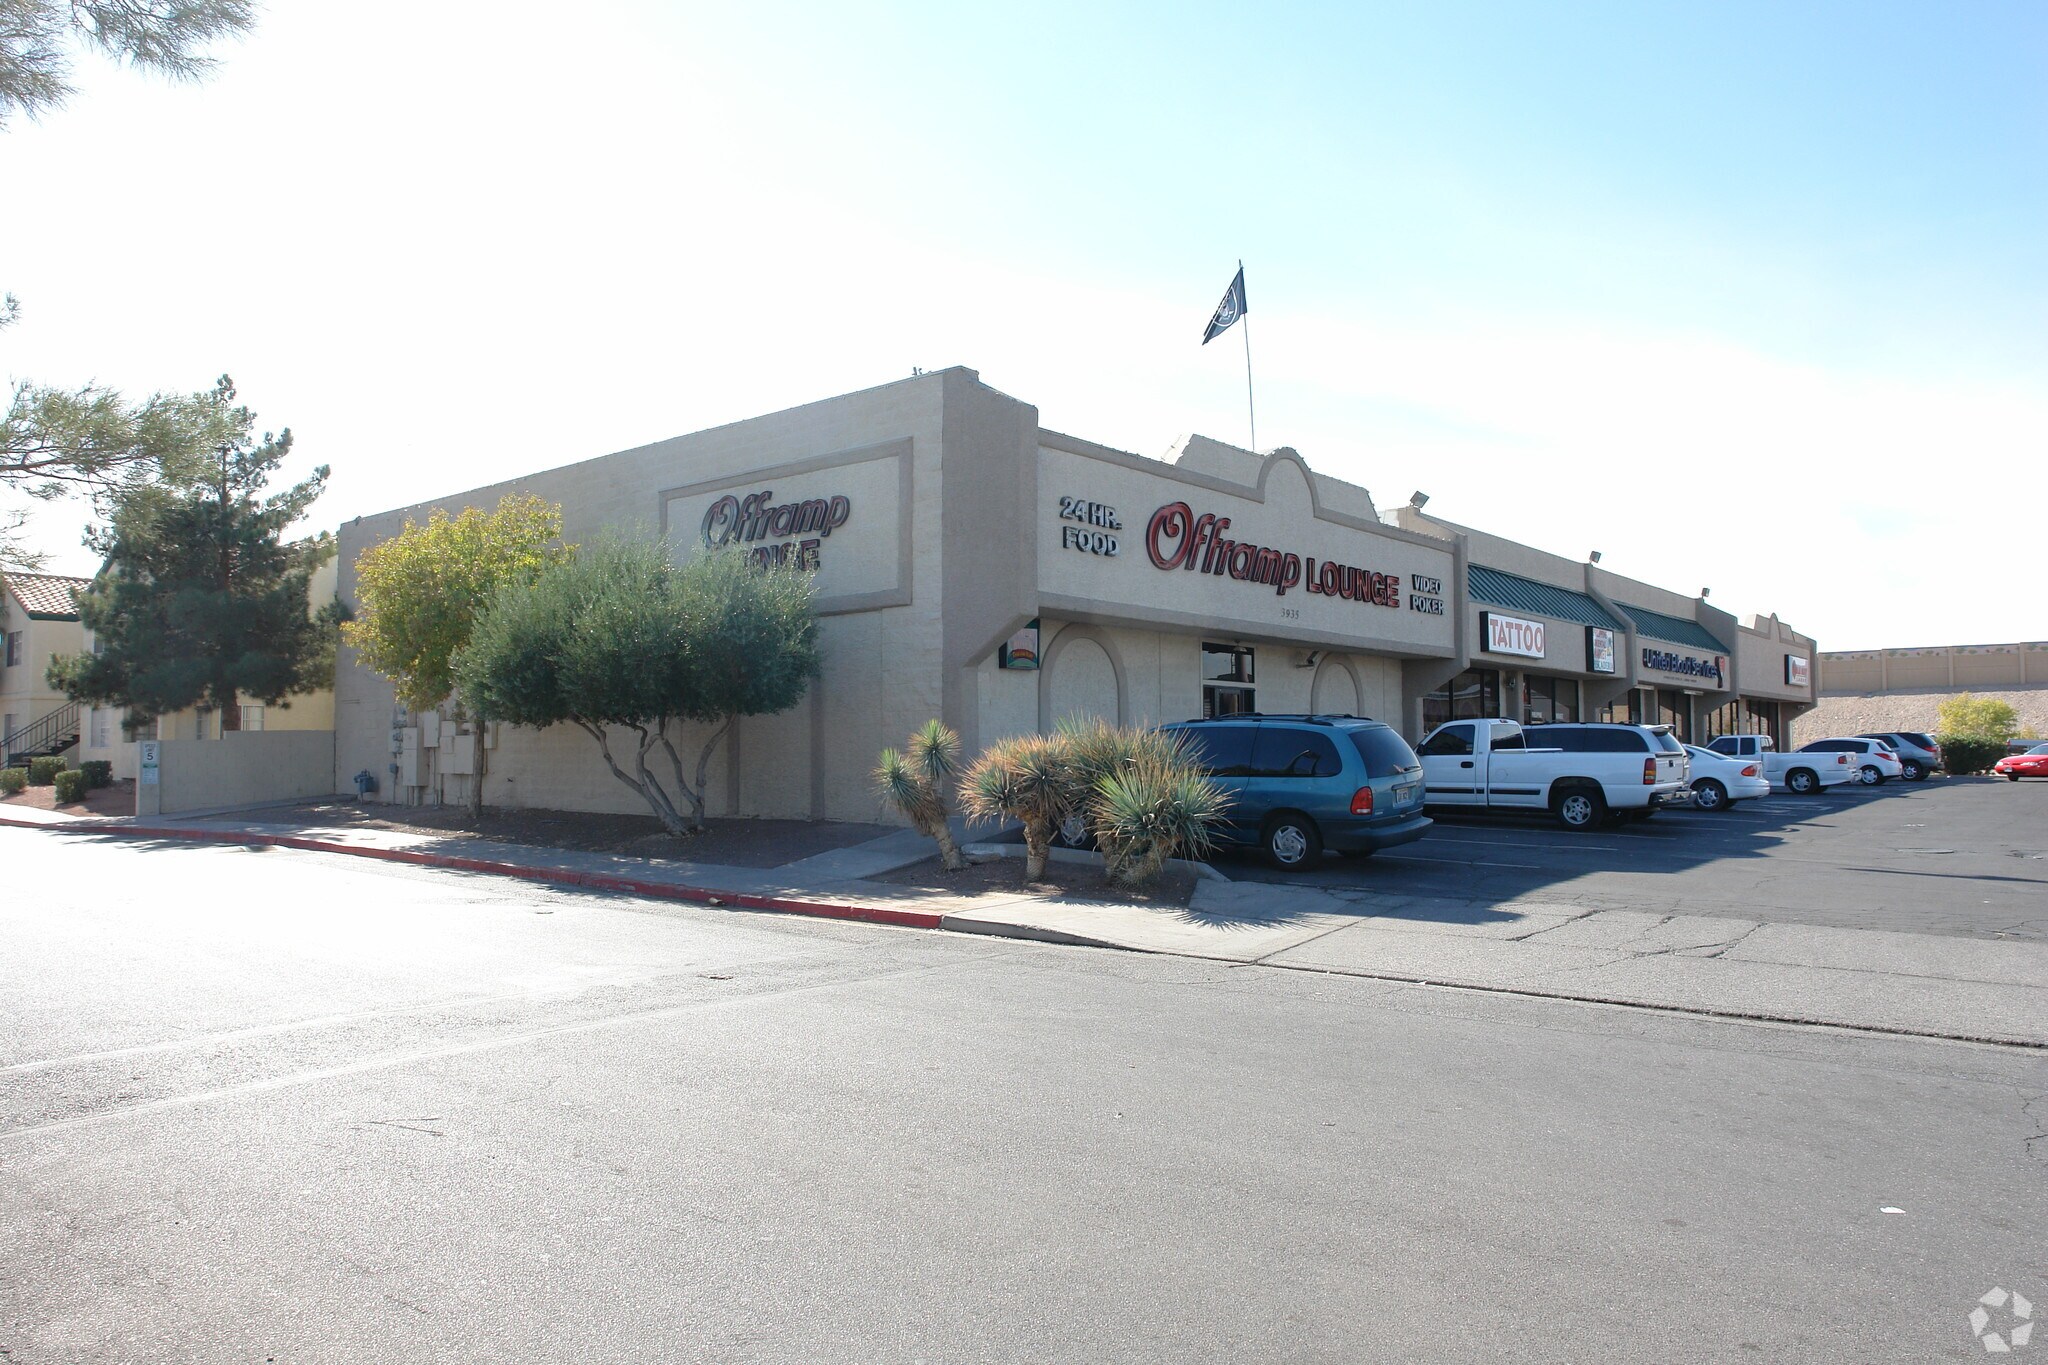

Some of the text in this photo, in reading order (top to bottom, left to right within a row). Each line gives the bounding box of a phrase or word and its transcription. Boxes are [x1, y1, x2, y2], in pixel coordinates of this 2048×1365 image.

[701, 490, 850, 549] Offramp
[1059, 496, 1087, 522] 24
[1062, 526, 1120, 557] FOOD
[1145, 501, 1400, 608] Offramp LOUNGE
[1411, 574, 1442, 594] VIDEO
[1280, 607, 1300, 620] 3935
[1410, 594, 1444, 615] POKER
[1490, 618, 1543, 653] TATTOO
[1643, 648, 1717, 678] United Blood Services
[146, 752, 154, 761] 5
